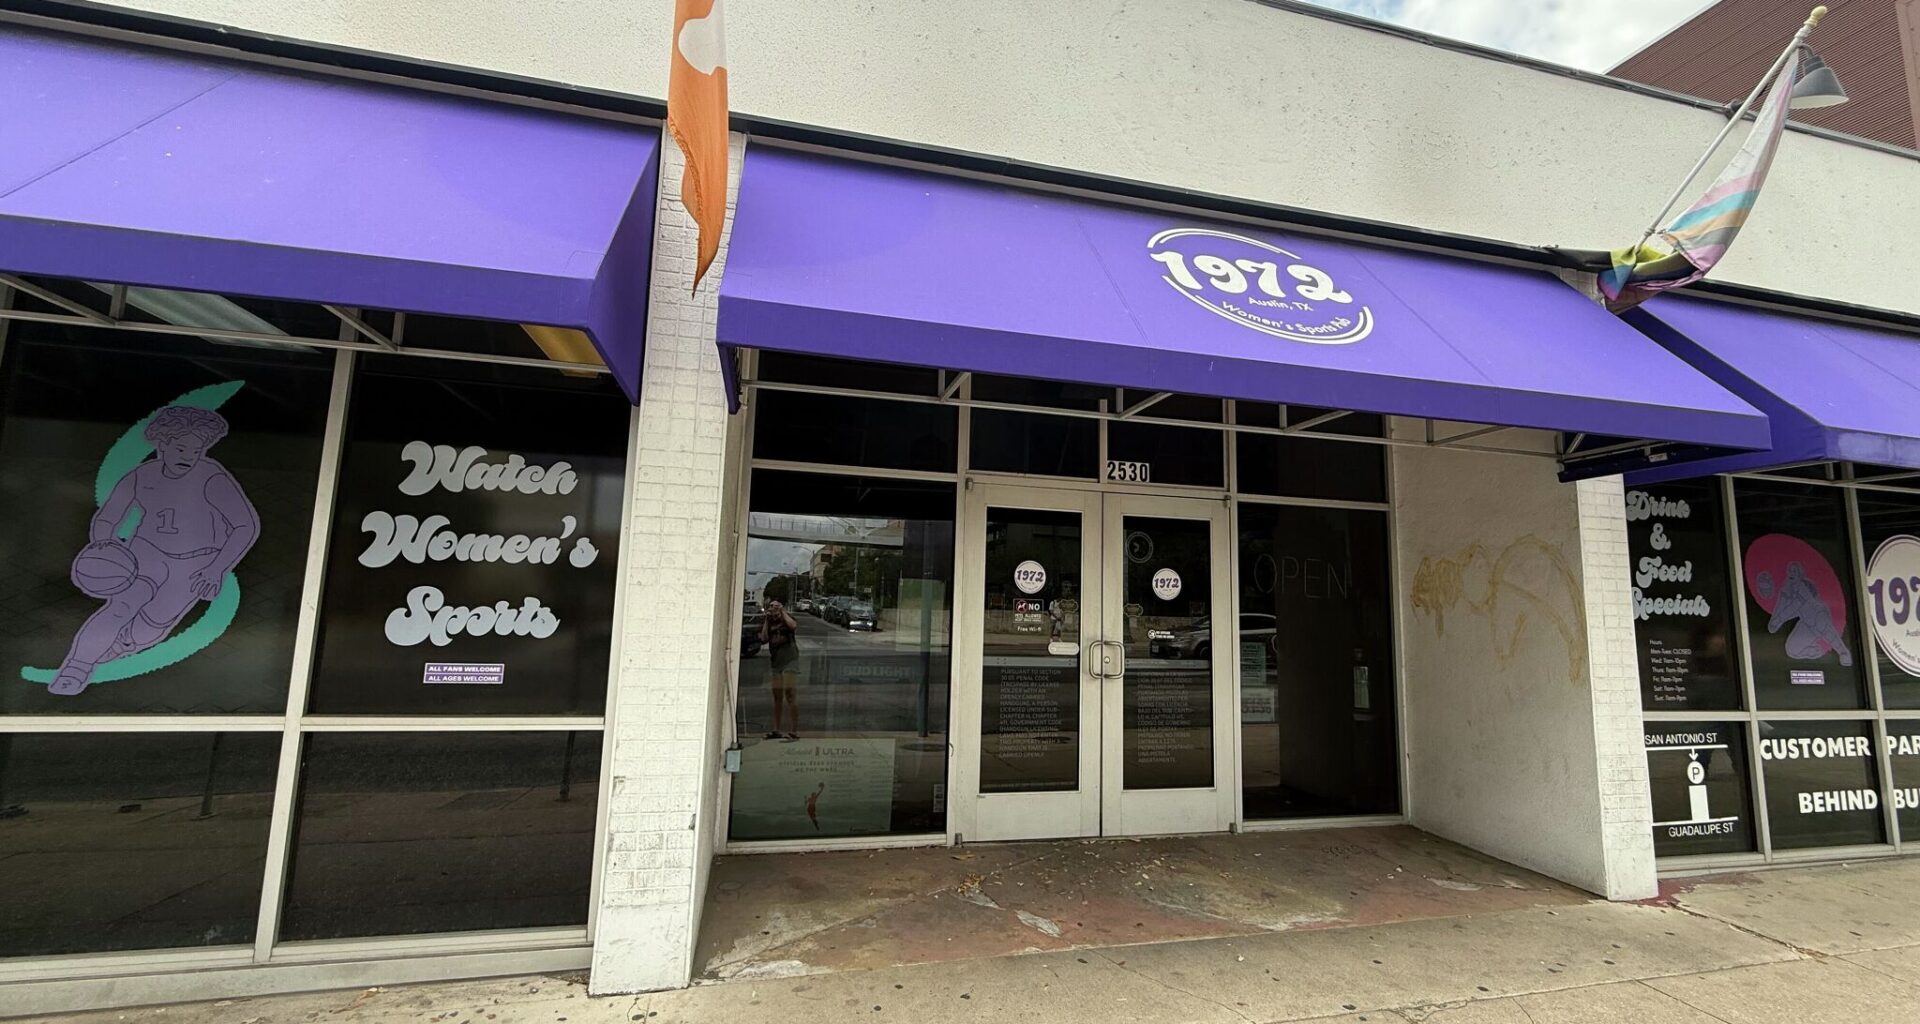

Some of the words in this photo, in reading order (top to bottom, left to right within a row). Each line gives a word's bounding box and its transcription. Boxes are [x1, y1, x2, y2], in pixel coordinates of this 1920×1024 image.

[1150, 251, 1353, 304] 1972
[1248, 297, 1294, 311] Austin,
[1292, 301, 1315, 312] TX
[1222, 301, 1295, 331] Women's
[1295, 322, 1337, 335] Sports
[398, 440, 579, 496] Watch
[1107, 461, 1148, 482] 2530
[1626, 490, 1690, 521] Drink
[358, 510, 599, 568] Women's
[1650, 522, 1671, 550] &
[1016, 569, 1044, 582] 1972
[1154, 577, 1180, 589] 1972
[1254, 553, 1348, 600] OPEN
[1636, 556, 1692, 588] Food
[384, 586, 561, 646] Sports
[1028, 603, 1040, 611] NO
[872, 664, 912, 678] LIGHT
[1644, 734, 1663, 745] SAN
[1665, 733, 1705, 744] ANTONIO
[1706, 732, 1718, 743] ST
[1760, 736, 1872, 760] CUSTOMER
[822, 747, 855, 756] ULTRA
[1691, 766, 1700, 780] P
[1797, 788, 1878, 814] BEHIND
[1893, 788, 1920, 808] BU
[1668, 823, 1722, 837] GUADALUPE
[1722, 822, 1734, 833] ST
